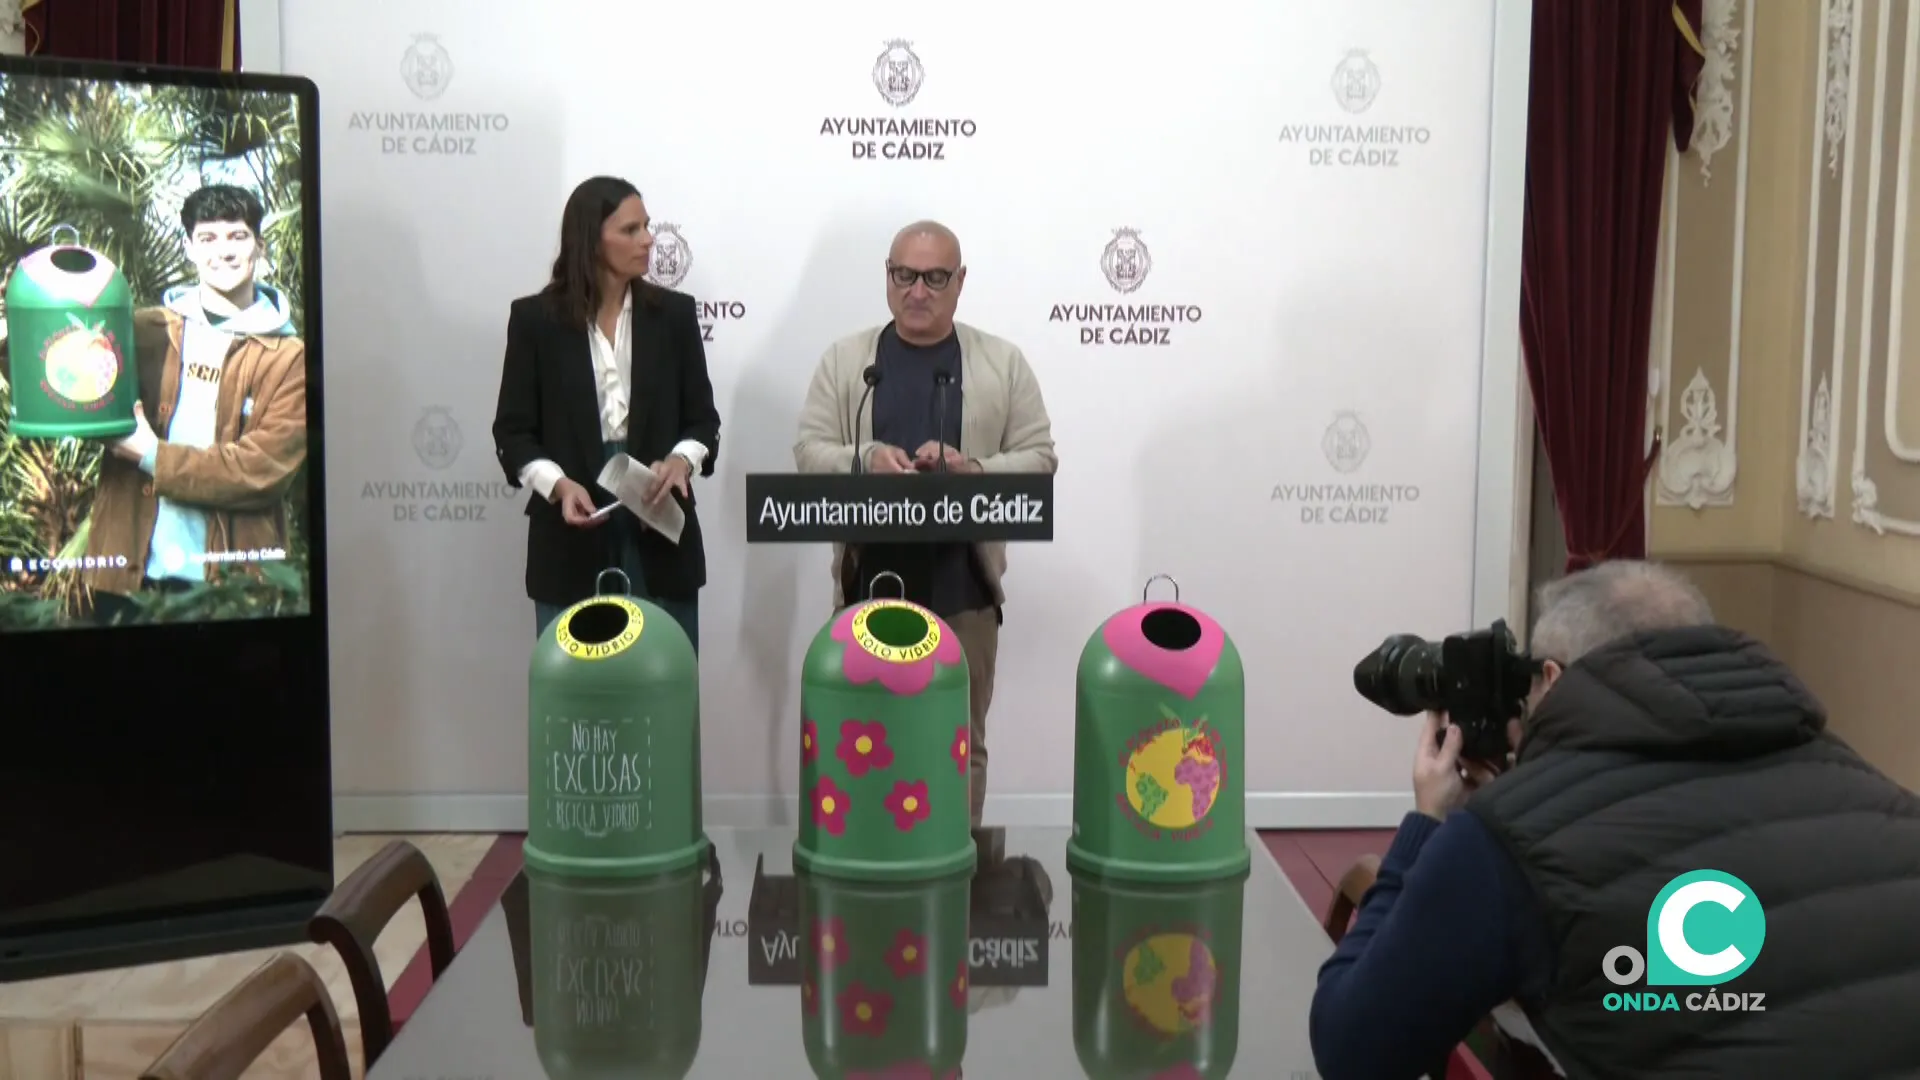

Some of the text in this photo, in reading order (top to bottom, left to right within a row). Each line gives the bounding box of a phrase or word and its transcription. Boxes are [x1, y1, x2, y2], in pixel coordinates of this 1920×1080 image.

[348, 114, 508, 131] AYUNTAMIENTO
[820, 118, 976, 136] AYUNTAMIENTO
[382, 133, 476, 154] DE CÁDIZ
[1279, 126, 1430, 145] AYUNTAMIENTO
[853, 138, 945, 159] DE CÁDIZ
[1310, 146, 1398, 167] DE CÁDIZ
[1049, 305, 1201, 323] AYUNTAMIENTO
[1080, 324, 1171, 344] DE CÁDIZ
[361, 481, 518, 499] AYUNTAMIENTO
[1271, 486, 1420, 502] AYUNTAMIENTO
[394, 501, 487, 521] DE CÁDIZ
[759, 493, 1043, 531] Ayuntamiento de Cádiz
[1300, 503, 1389, 524] DE CÁDIZ
[585, 631, 634, 656] VIDRIO
[857, 631, 938, 661] SOLO VIDRIO
[572, 721, 617, 753] NO HAY
[554, 751, 641, 794] EXCUSAS
